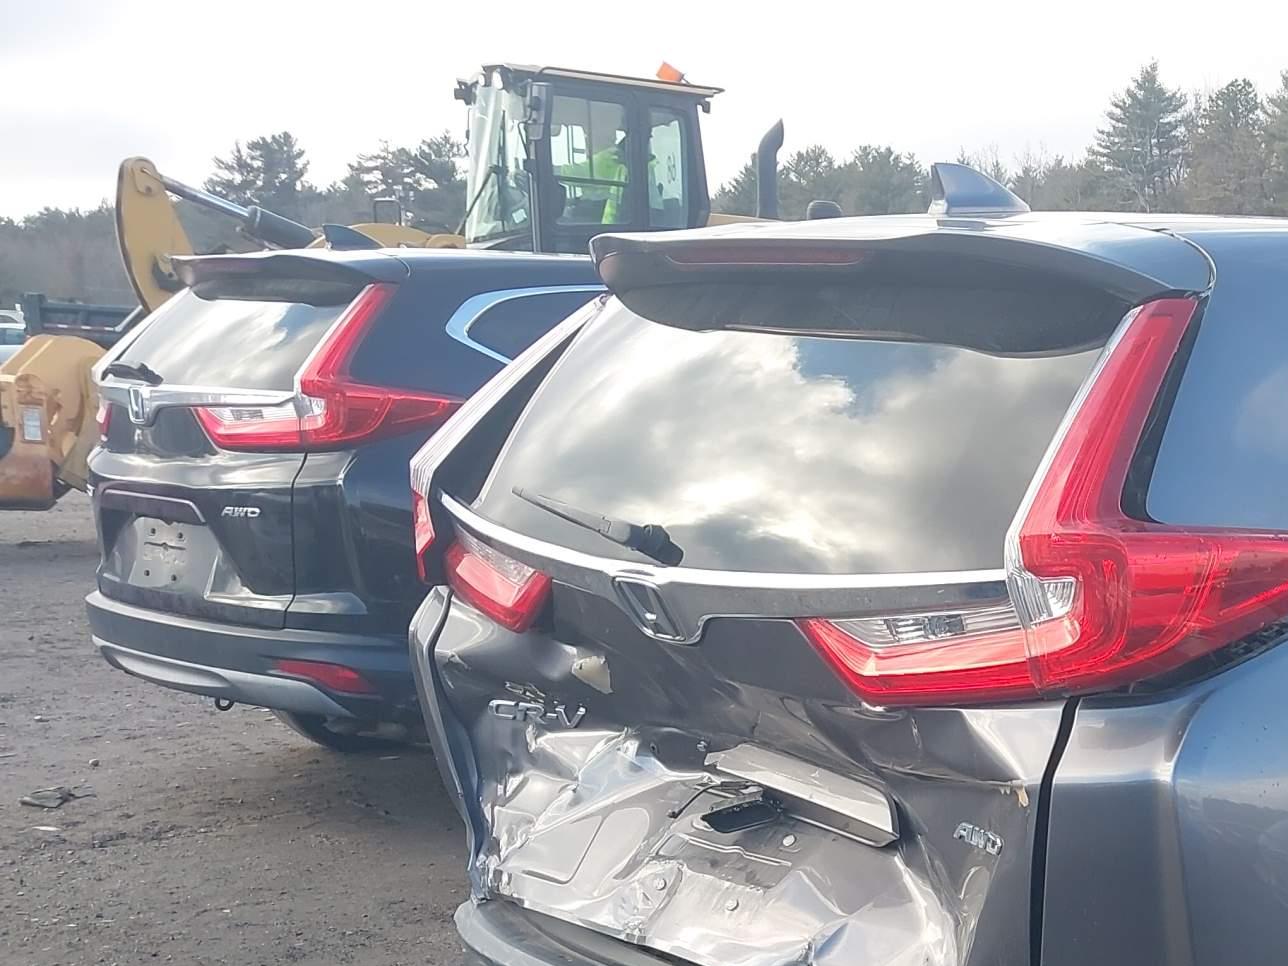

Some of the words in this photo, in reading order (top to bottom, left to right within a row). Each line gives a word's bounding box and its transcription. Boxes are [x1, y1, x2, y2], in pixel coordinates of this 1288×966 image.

[220, 506, 261, 517] AWD
[487, 699, 586, 729] CR-V
[953, 822, 1003, 855] AWD
